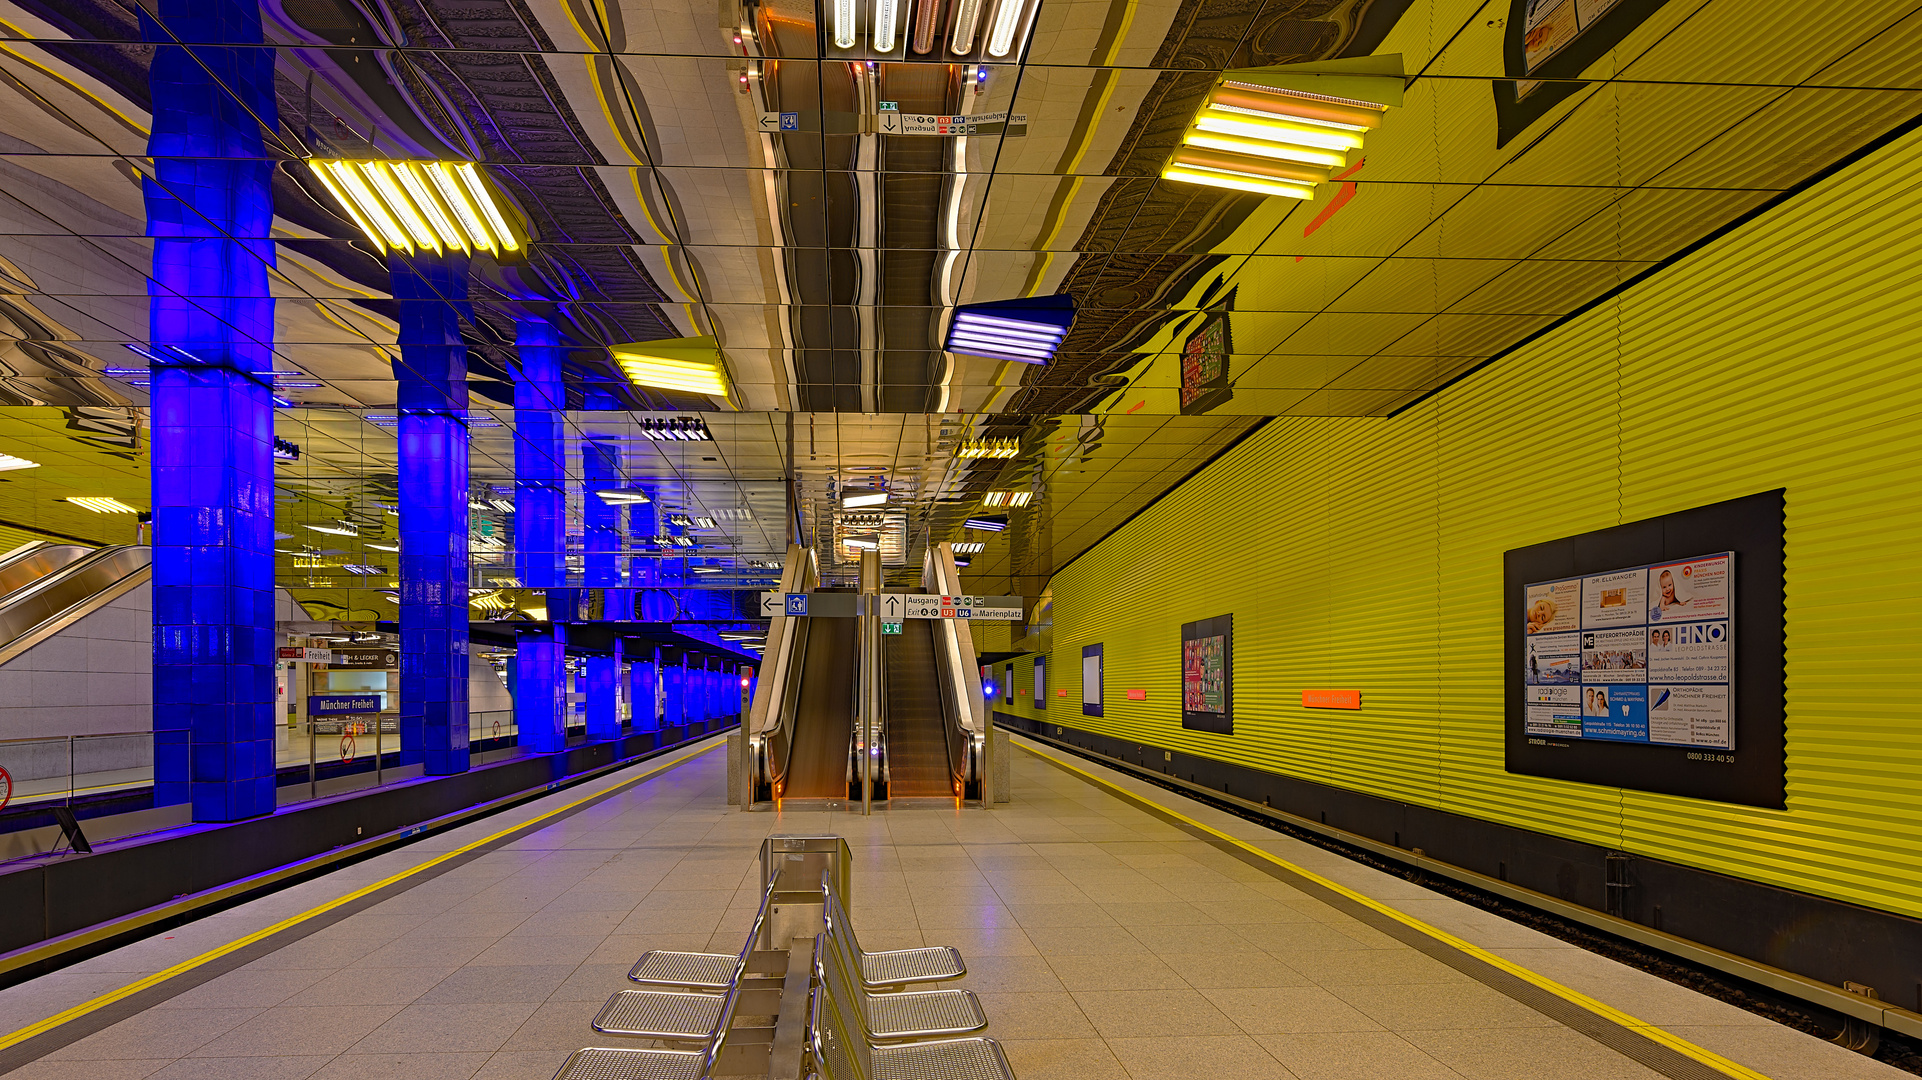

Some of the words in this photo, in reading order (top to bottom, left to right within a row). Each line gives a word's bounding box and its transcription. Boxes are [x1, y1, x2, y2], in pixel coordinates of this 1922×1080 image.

[1602, 572, 1636, 582] ELLWANGER
[908, 597, 938, 606] Ausgang
[979, 610, 1021, 618] Marienplatz
[1596, 630, 1644, 639] KIEFERORTHOPÄDIE
[1676, 624, 1726, 644] HNO
[1584, 637, 1593, 646] ME
[309, 651, 330, 660] Freiheit
[1650, 673, 1727, 681] www.hno-leopoldstrasse.de
[1308, 694, 1330, 704] Münchner
[1332, 694, 1352, 704] Freiheit
[320, 700, 350, 710] Münchner
[352, 699, 374, 709] Freiheit
[1585, 728, 1645, 738] www.schmidmayring.de
[1687, 752, 1702, 760] 0800
